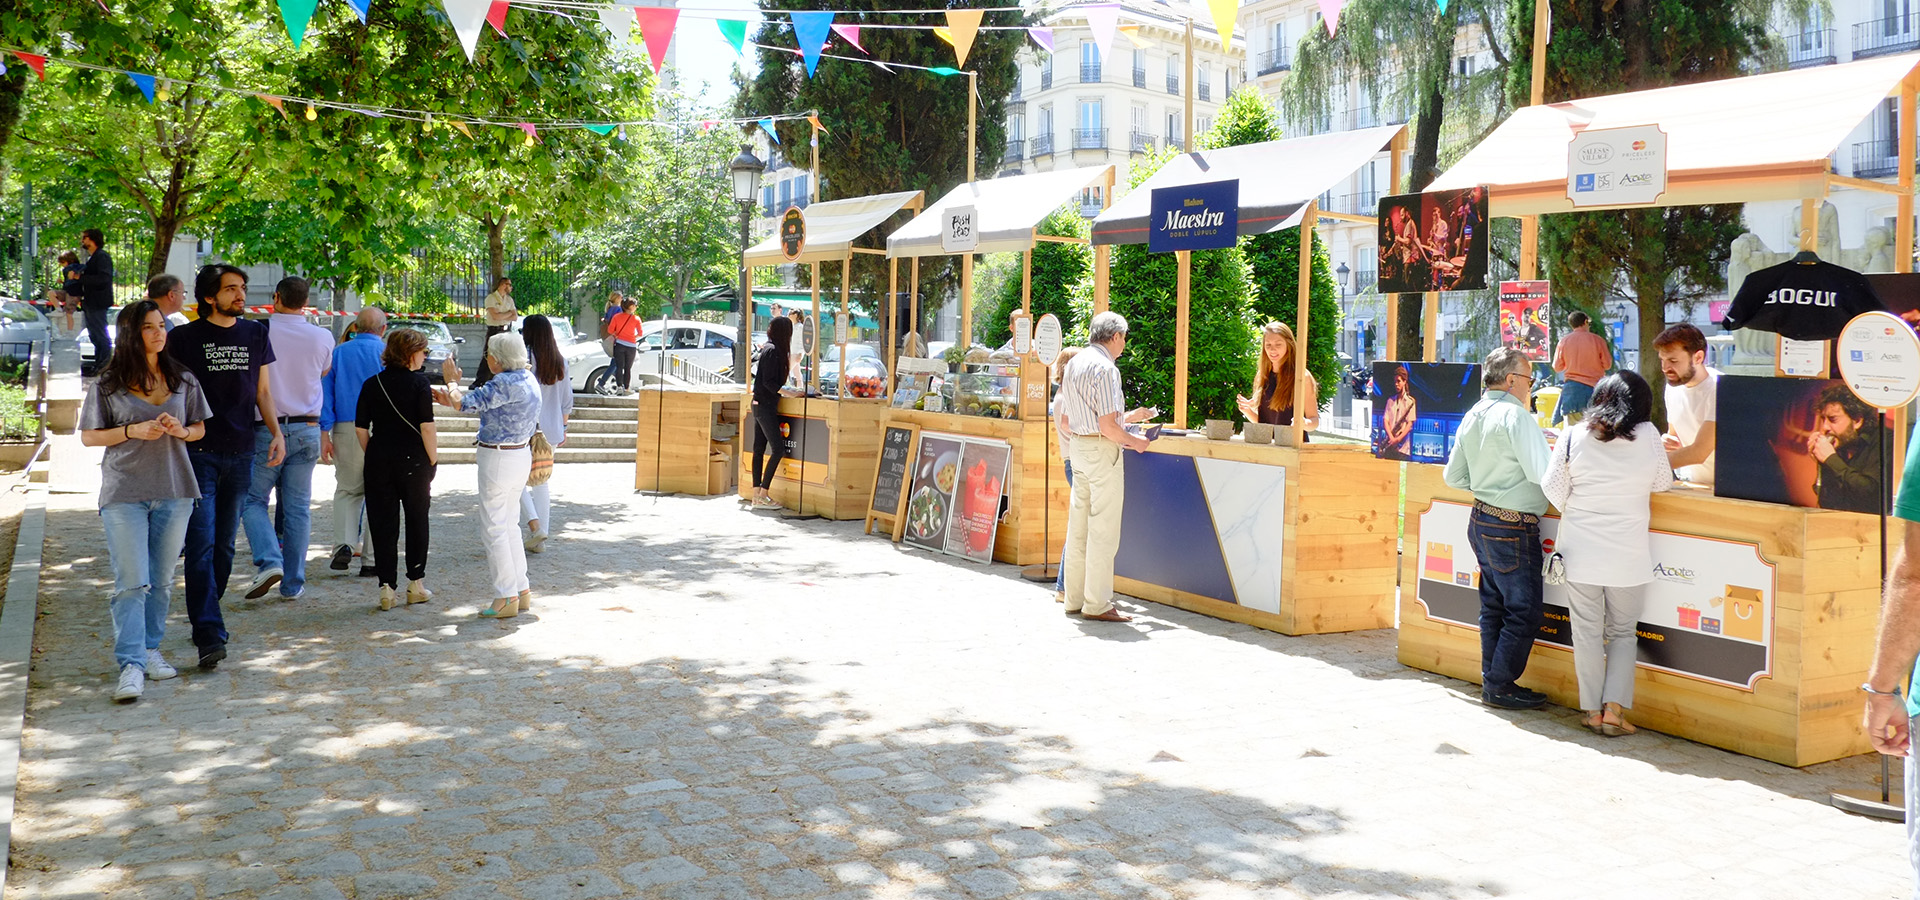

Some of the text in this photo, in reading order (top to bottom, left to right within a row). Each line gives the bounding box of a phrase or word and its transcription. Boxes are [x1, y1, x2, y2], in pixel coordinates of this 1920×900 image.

[1582, 147, 1610, 155] SALESAS
[1160, 208, 1224, 231] Maestra
[205, 351, 231, 359] DON'T
